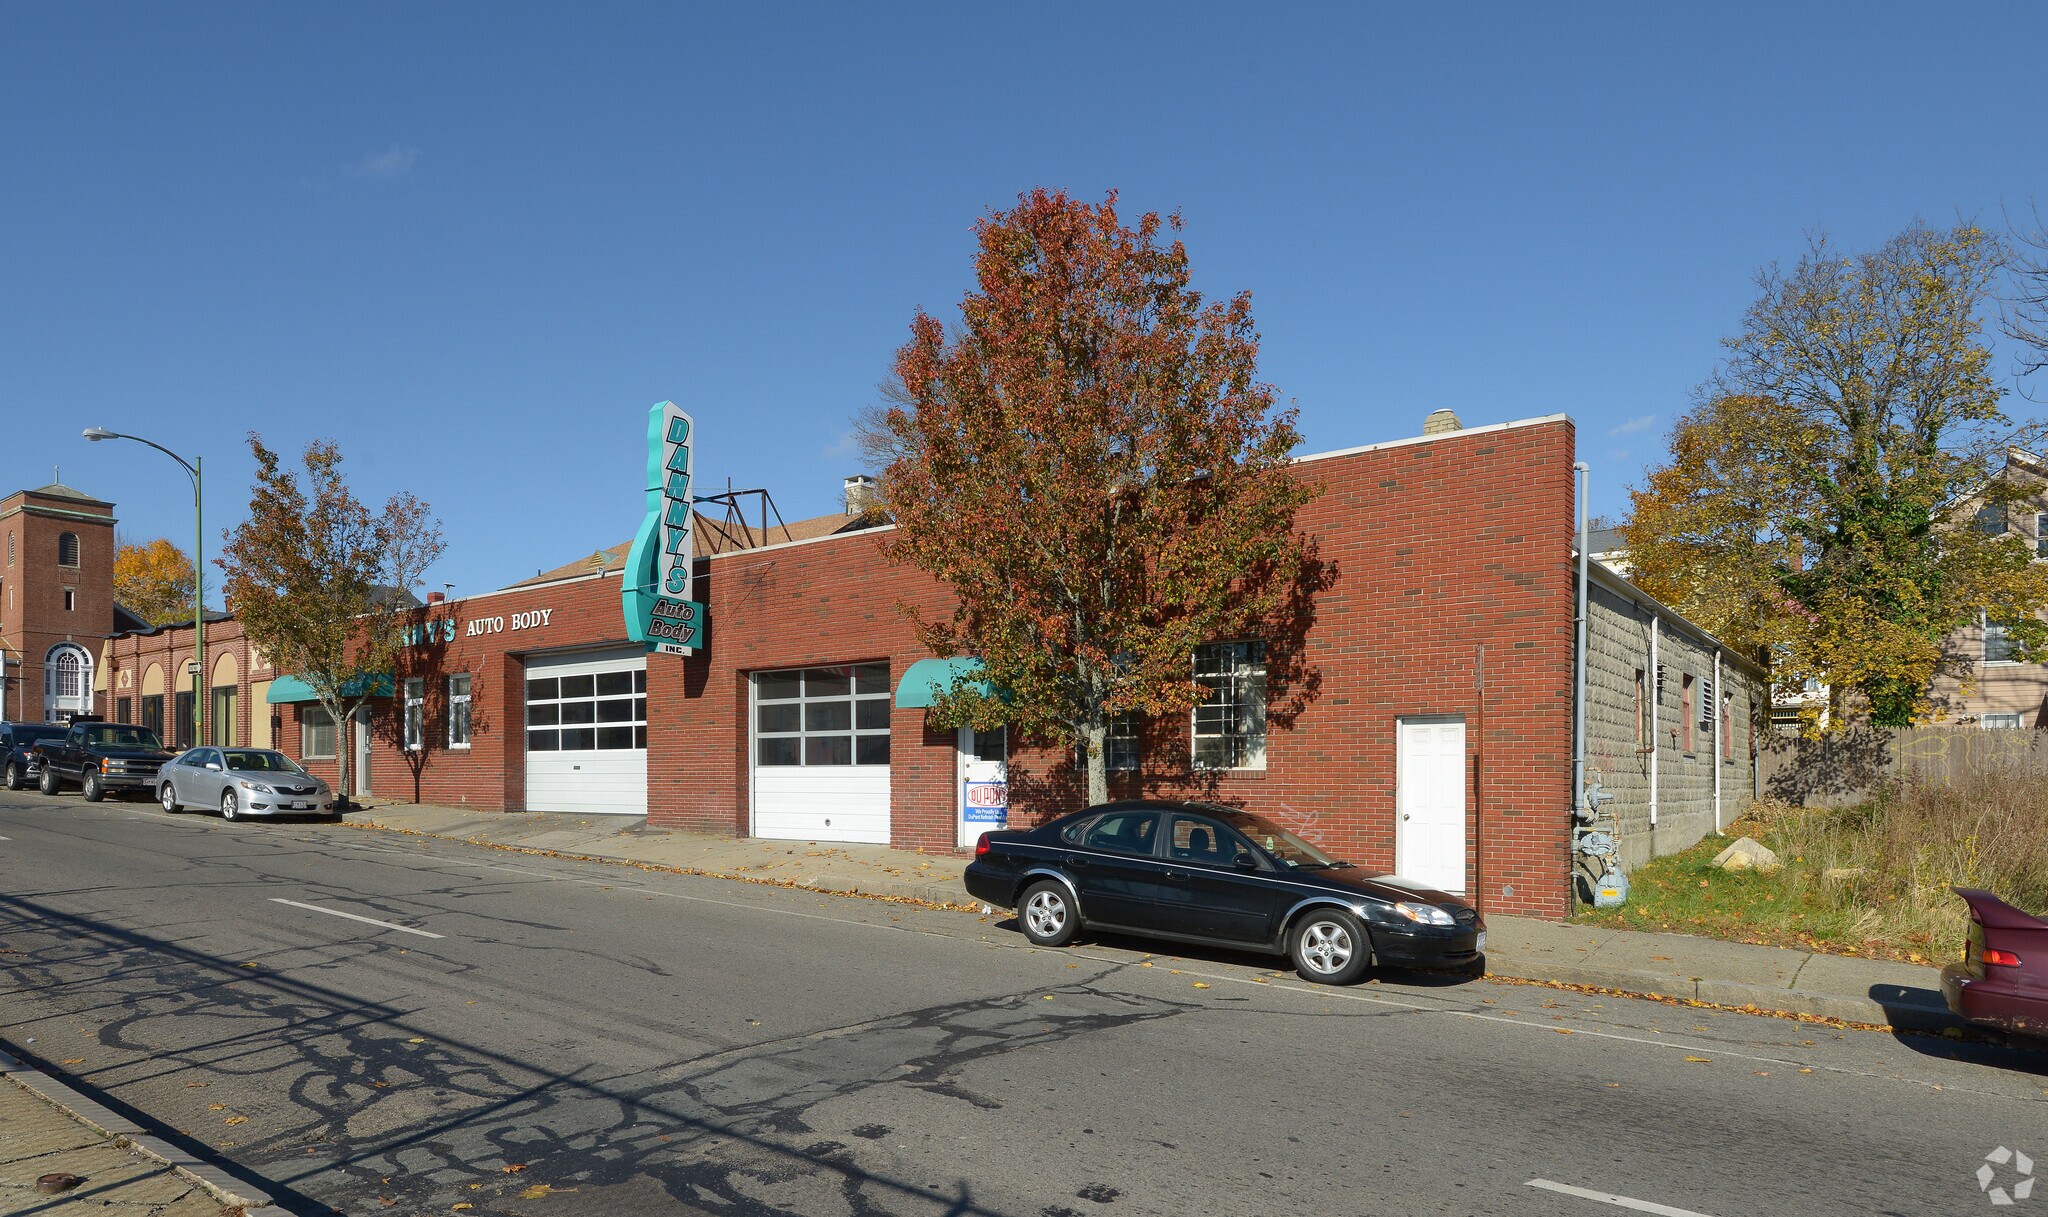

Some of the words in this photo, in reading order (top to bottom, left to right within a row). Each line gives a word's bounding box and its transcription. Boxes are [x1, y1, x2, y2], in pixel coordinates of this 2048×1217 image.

[665, 415, 690, 594] DANNY'S
[466, 616, 504, 637] AUTO
[511, 608, 553, 631] BODY
[650, 599, 695, 620] Auto
[647, 618, 695, 644] Body
[665, 645, 685, 655] INC.
